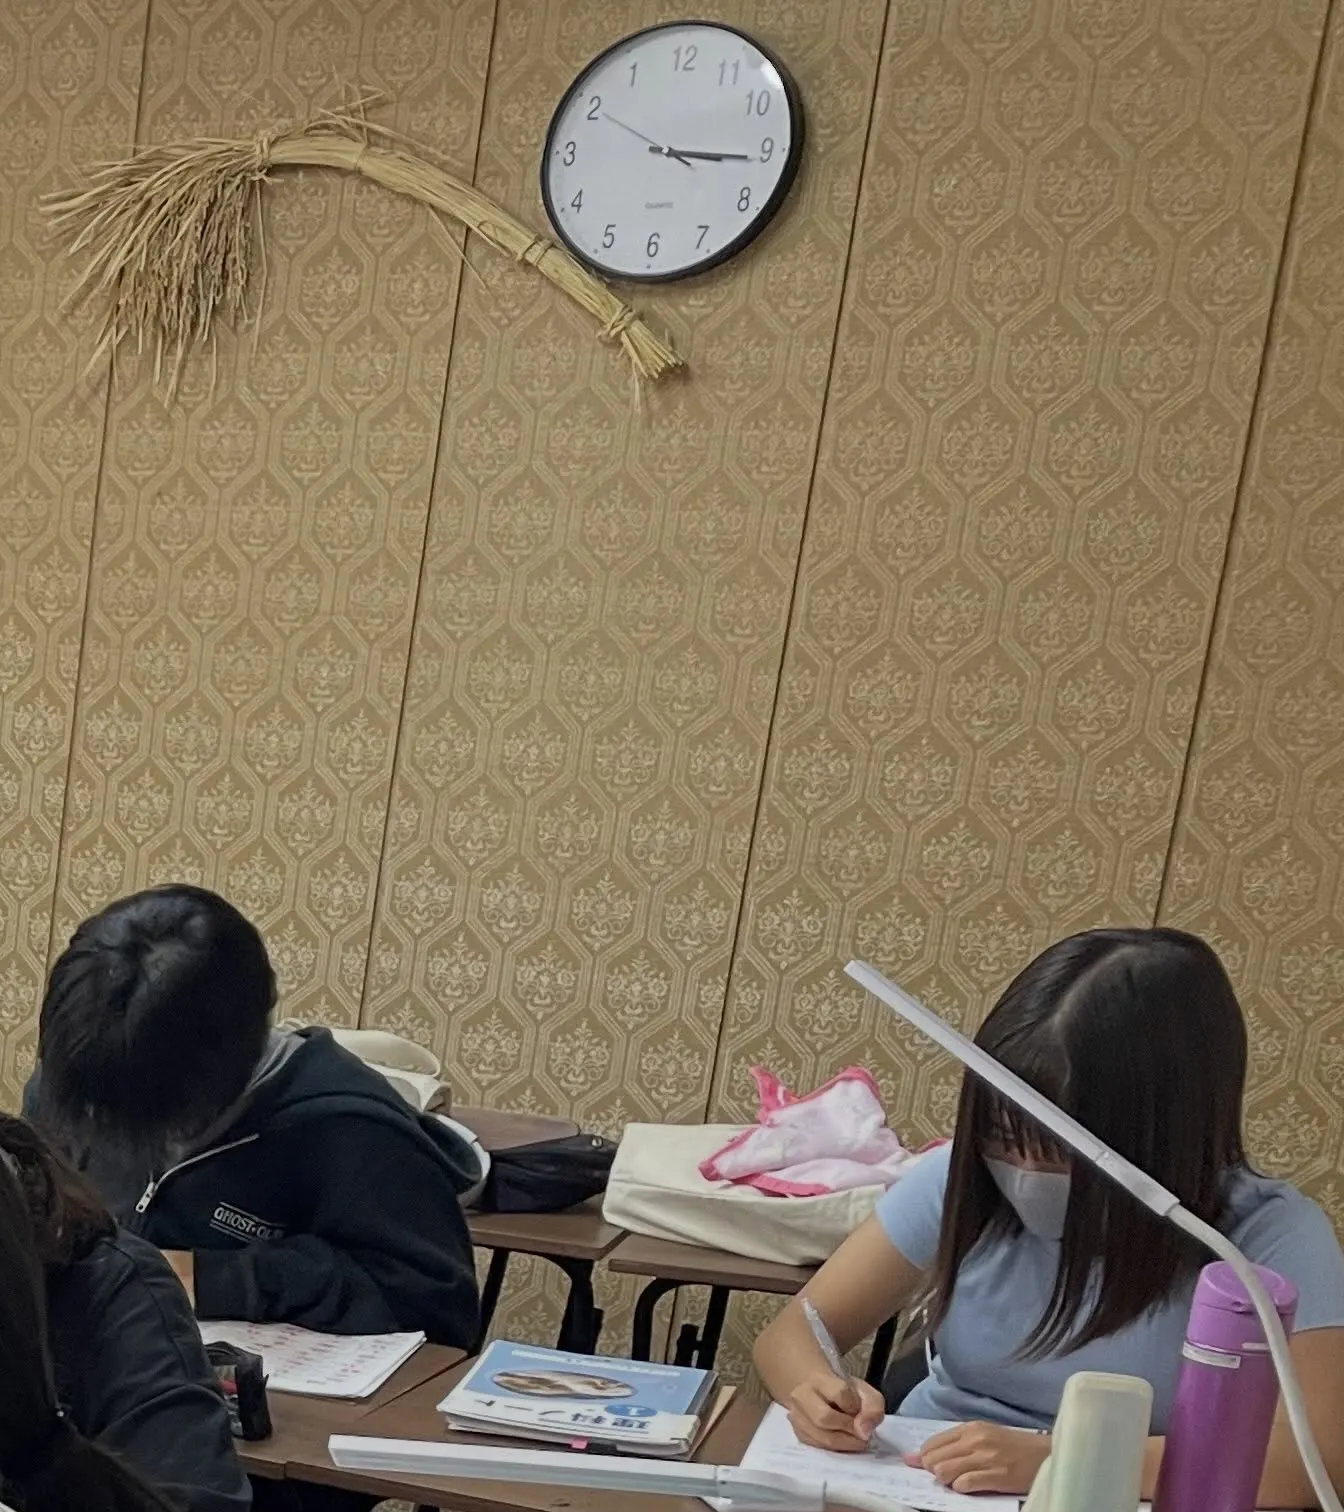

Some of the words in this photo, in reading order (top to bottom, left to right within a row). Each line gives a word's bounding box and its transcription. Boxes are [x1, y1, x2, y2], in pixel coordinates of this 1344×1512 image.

[673, 45, 698, 71] 12
[629, 63, 639, 87] 1
[718, 59, 740, 85] 11
[587, 96, 602, 120] 2
[745, 90, 770, 116] 10
[563, 142, 577, 166] 3
[760, 138, 774, 163] 9
[571, 189, 584, 213] 4
[737, 187, 751, 212] 8
[602, 224, 616, 249] 5
[647, 233, 660, 257] 6
[695, 225, 710, 250] 7
[475, 1399, 652, 1430] 理科ノート
